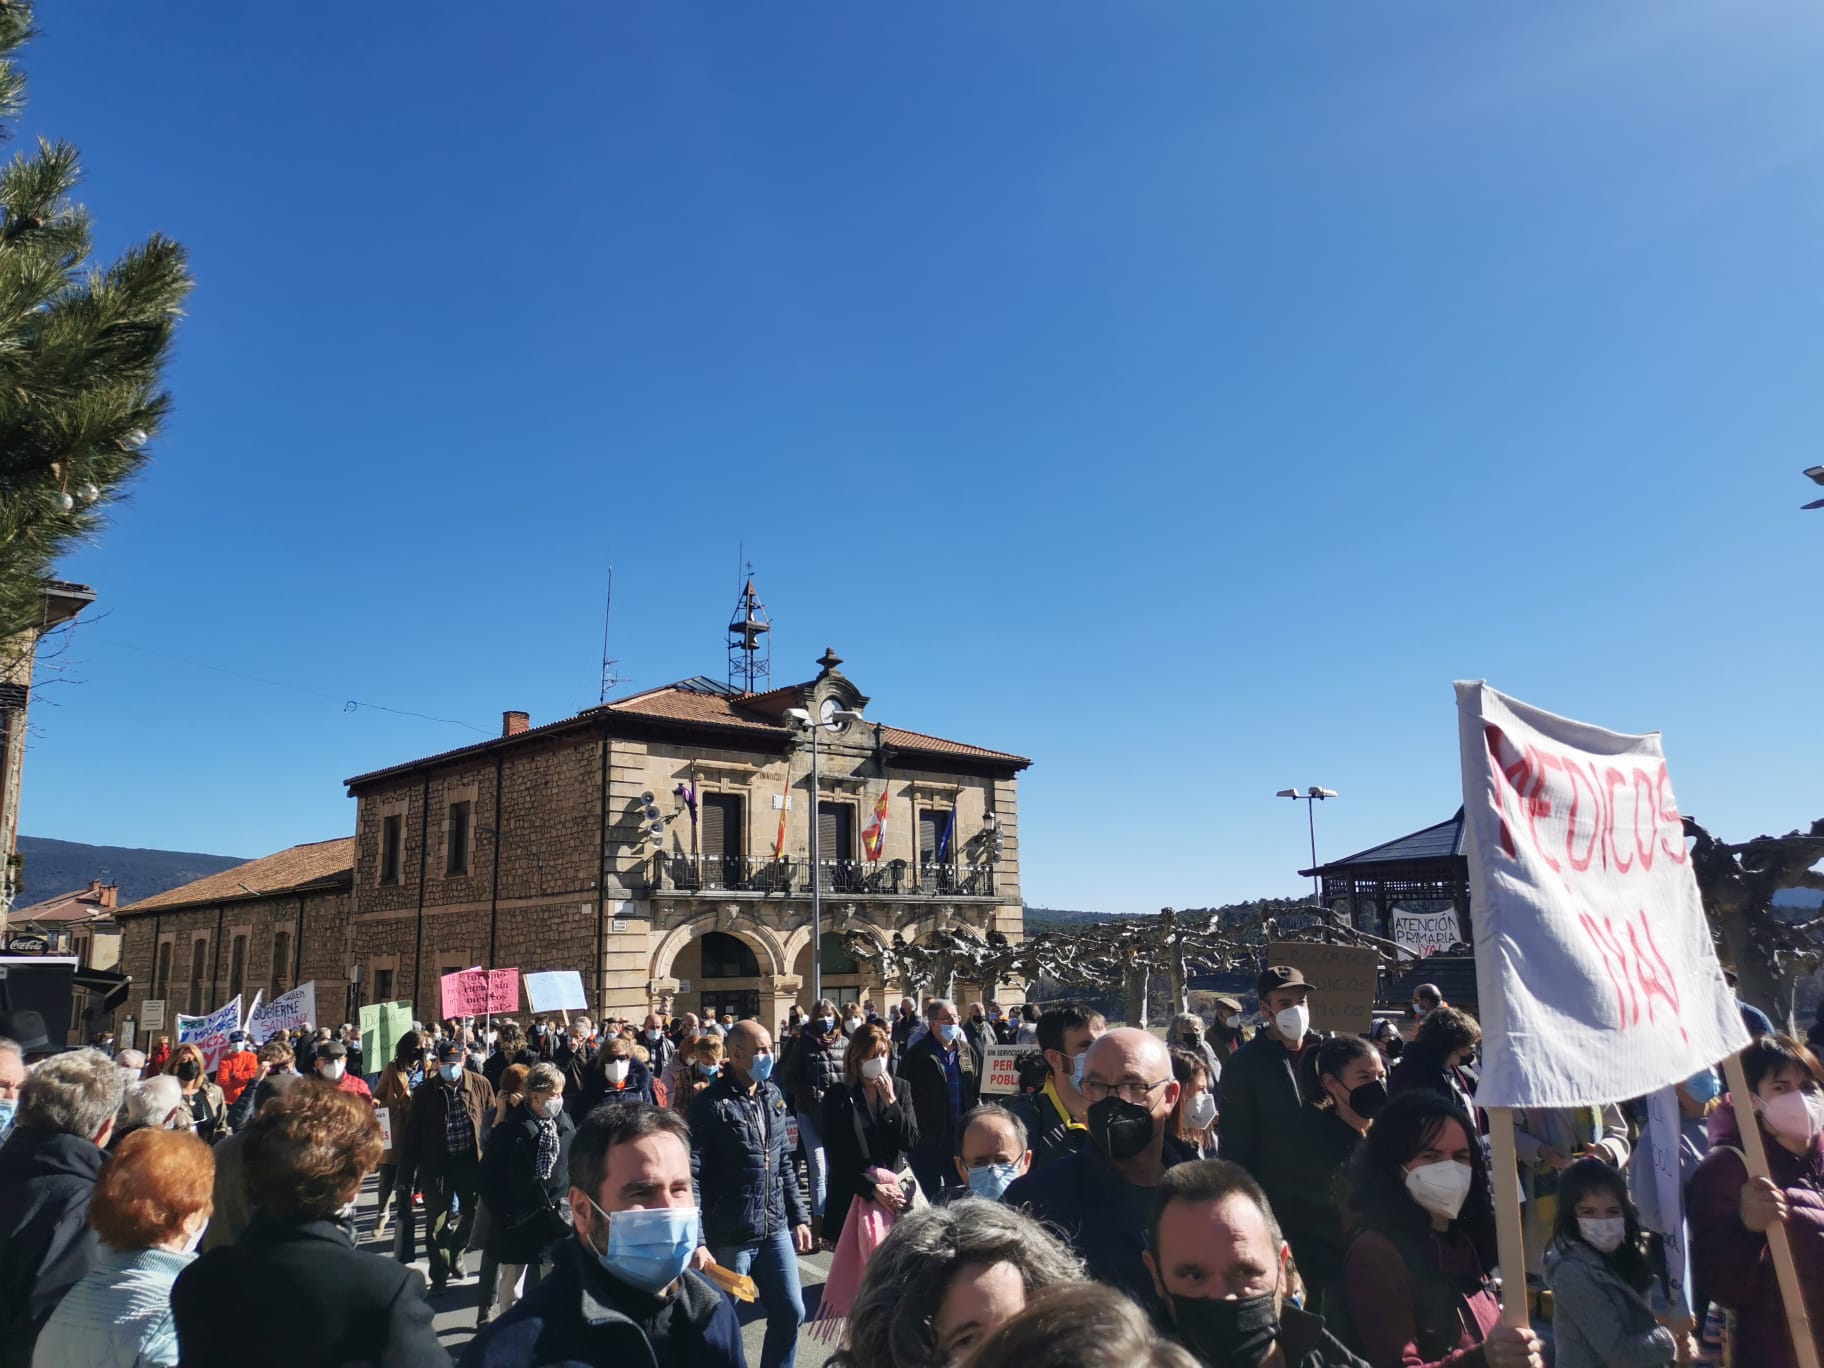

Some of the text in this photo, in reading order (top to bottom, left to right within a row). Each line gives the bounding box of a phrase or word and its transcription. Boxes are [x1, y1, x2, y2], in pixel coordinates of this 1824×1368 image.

[1484, 724, 1688, 874] MEDICOS
[1395, 912, 1456, 931] ATENCIÓN
[1396, 930, 1456, 944] PRIMARIA
[993, 1060, 1016, 1071] PER
